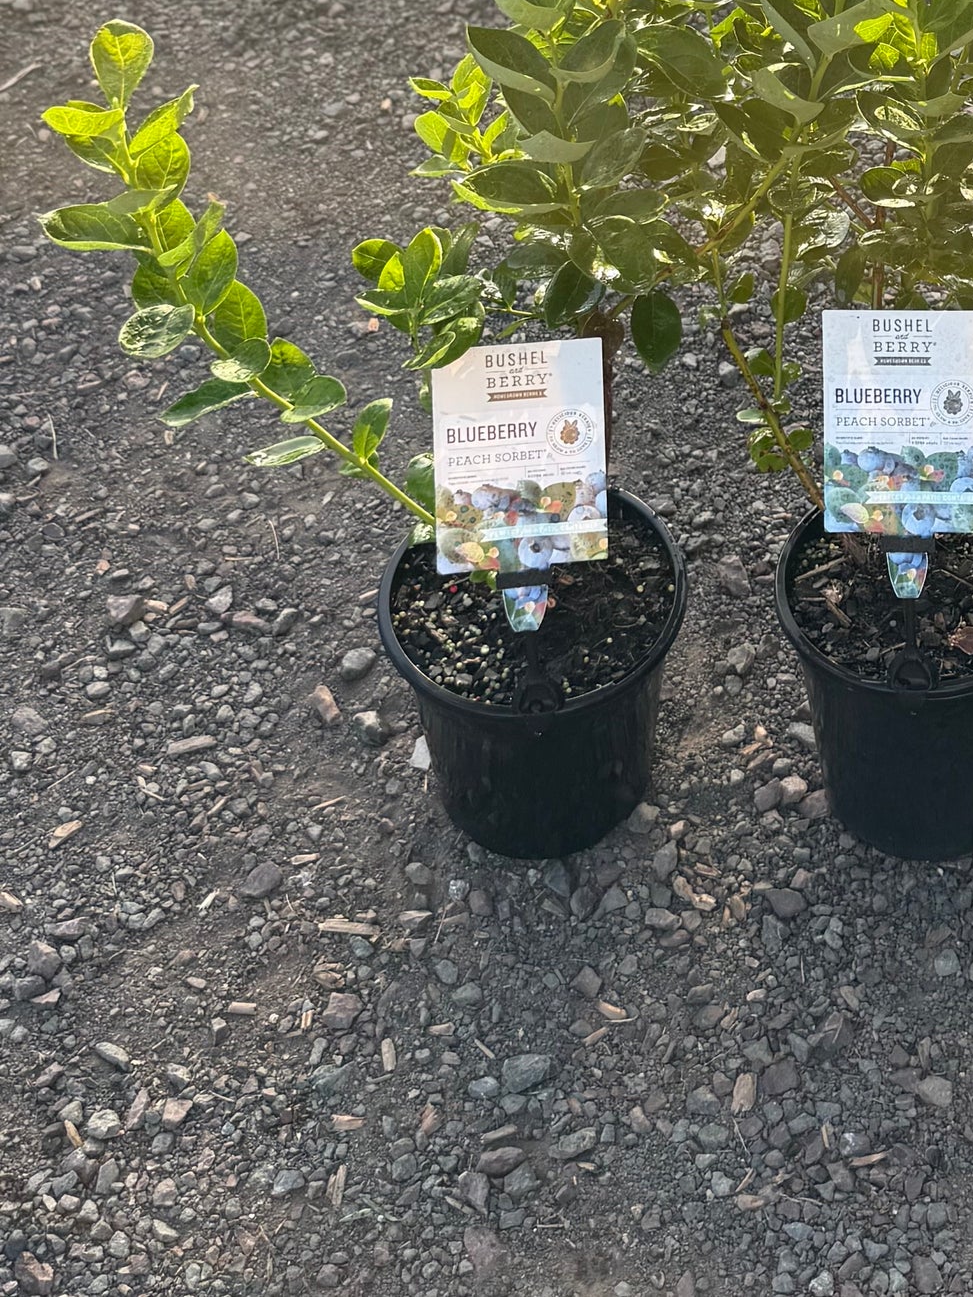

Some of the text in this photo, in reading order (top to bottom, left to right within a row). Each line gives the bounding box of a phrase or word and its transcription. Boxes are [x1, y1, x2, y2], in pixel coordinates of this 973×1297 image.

[872, 318, 933, 333] BUSHEL
[873, 341, 932, 353] BERRY
[485, 351, 549, 368] BUSHEL
[486, 373, 548, 389] BERRY
[835, 388, 922, 405] BLUEBERRY
[836, 416, 926, 427] PEACH SORBET
[447, 421, 538, 444] BLUEBERRY
[448, 450, 542, 467] PEACH SORBET
